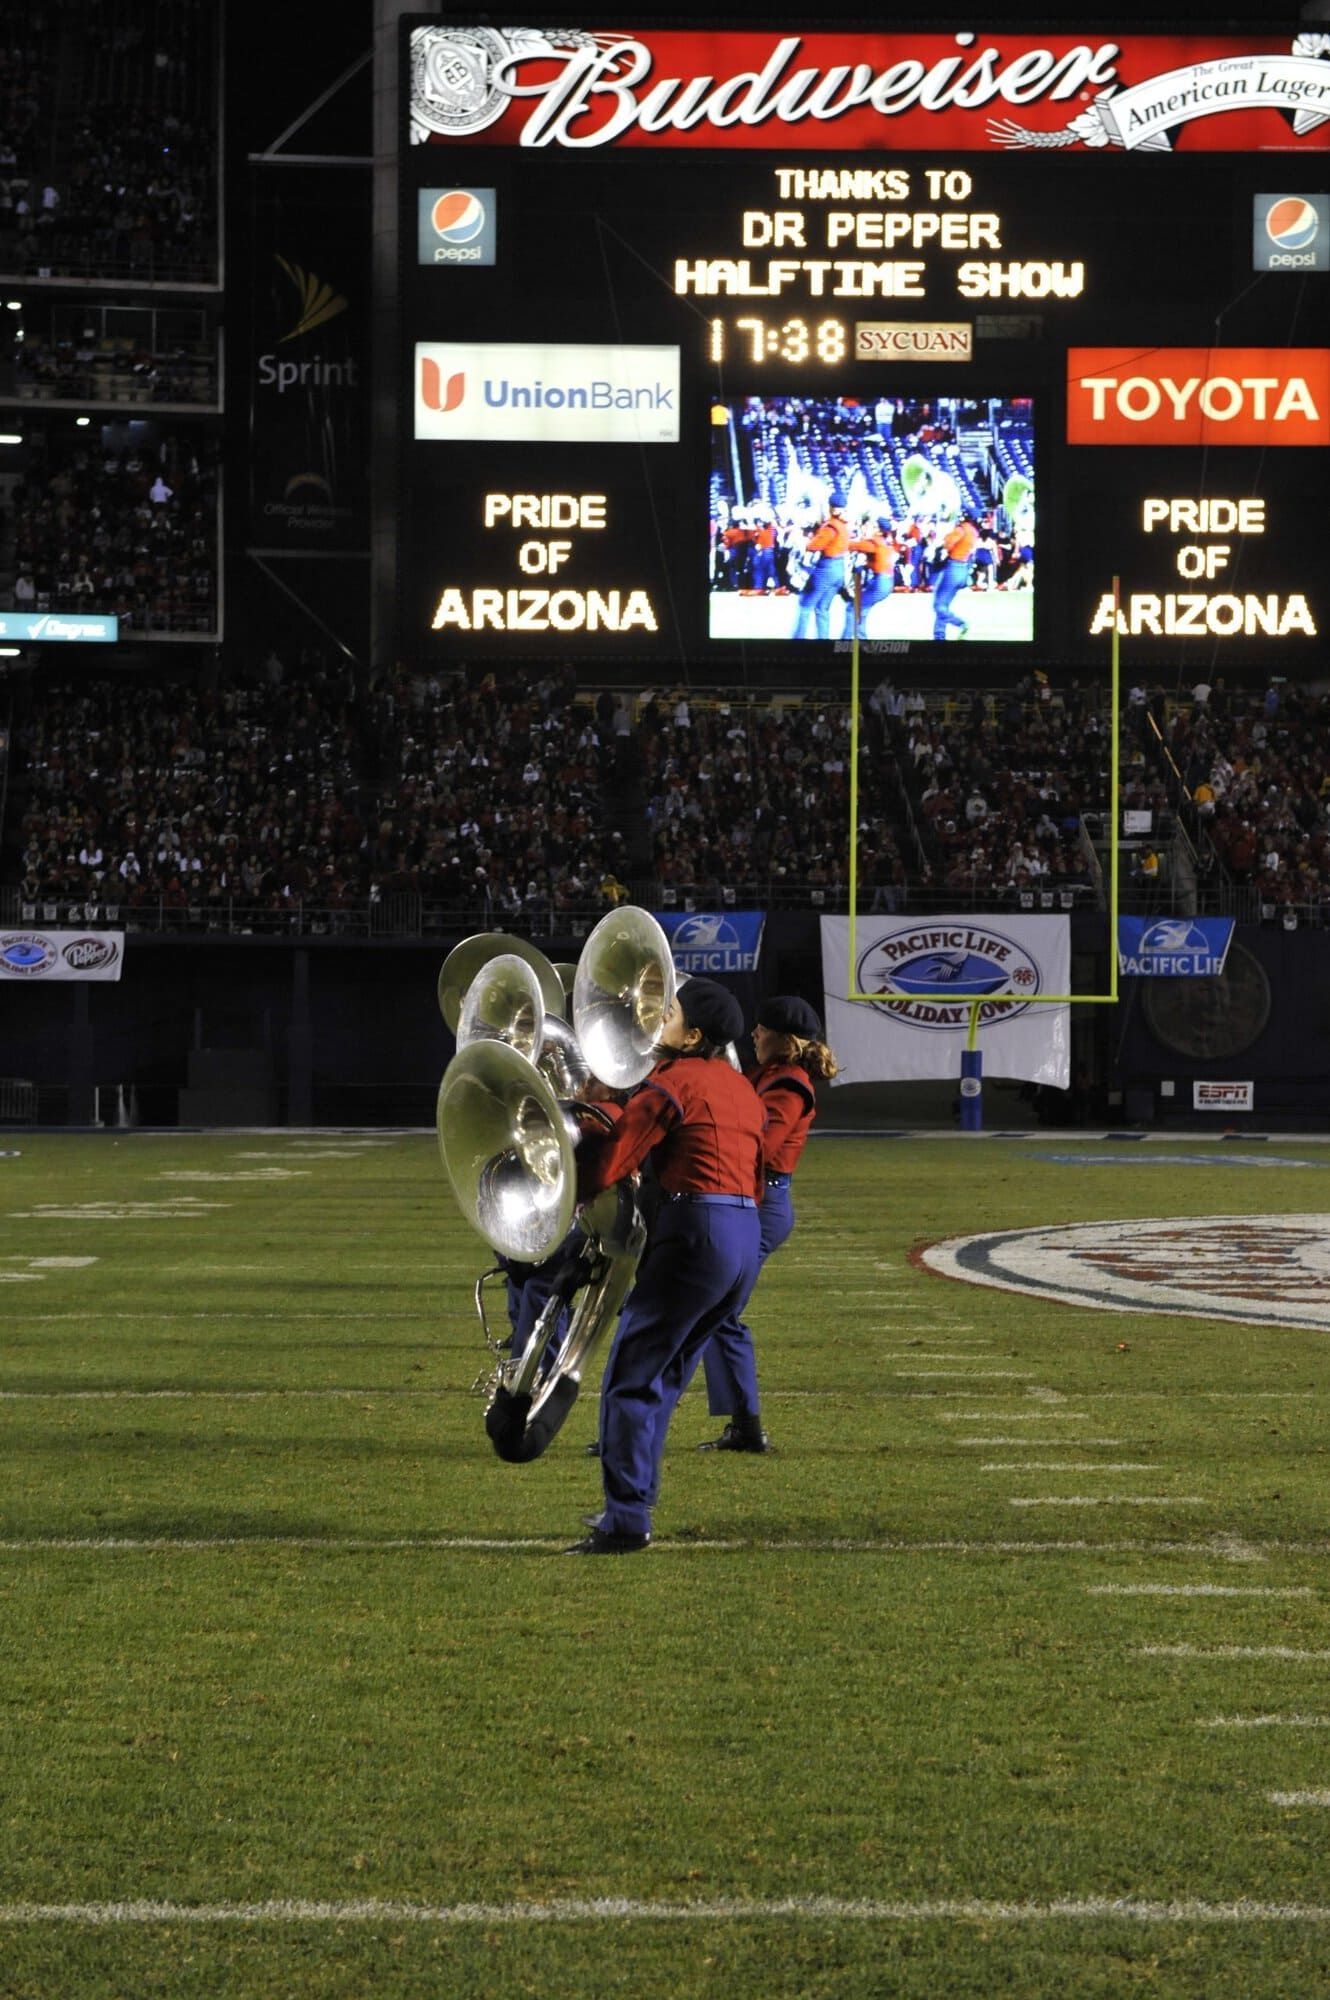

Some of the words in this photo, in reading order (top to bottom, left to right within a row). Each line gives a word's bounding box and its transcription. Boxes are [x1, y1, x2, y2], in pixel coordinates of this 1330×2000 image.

[1192, 66, 1214, 78] The
[1218, 61, 1254, 73] Great
[495, 33, 1120, 147] Budweiser
[1128, 78, 1248, 131] American
[1255, 71, 1330, 101] Lager
[775, 169, 911, 200] THANKS
[925, 171, 972, 200] TO
[743, 212, 807, 248] DR
[828, 213, 1002, 249] PEPPER
[434, 245, 481, 262] pepsi
[1269, 251, 1316, 268] pepsi
[675, 260, 926, 297] HALFTIME
[957, 262, 1085, 298] SHOW
[710, 319, 847, 363] 17:38
[859, 331, 968, 351] SYCUAN
[258, 354, 359, 393] Sprint
[485, 379, 673, 409] UnionBank
[1081, 378, 1319, 421] TOYOTA
[485, 494, 606, 528] PRIDE
[1144, 499, 1265, 533] PRIDE
[519, 541, 572, 574] OF
[1177, 545, 1230, 579] OF
[432, 589, 658, 631] ARIZONA
[1090, 594, 1317, 635] ARIZONA
[673, 952, 721, 971] CIFIC
[725, 950, 755, 971] LIF
[882, 932, 963, 961] PACIFIC
[964, 932, 1012, 961] LIFE
[1193, 953, 1223, 974] LIF
[1199, 1084, 1248, 1098] ESPN
